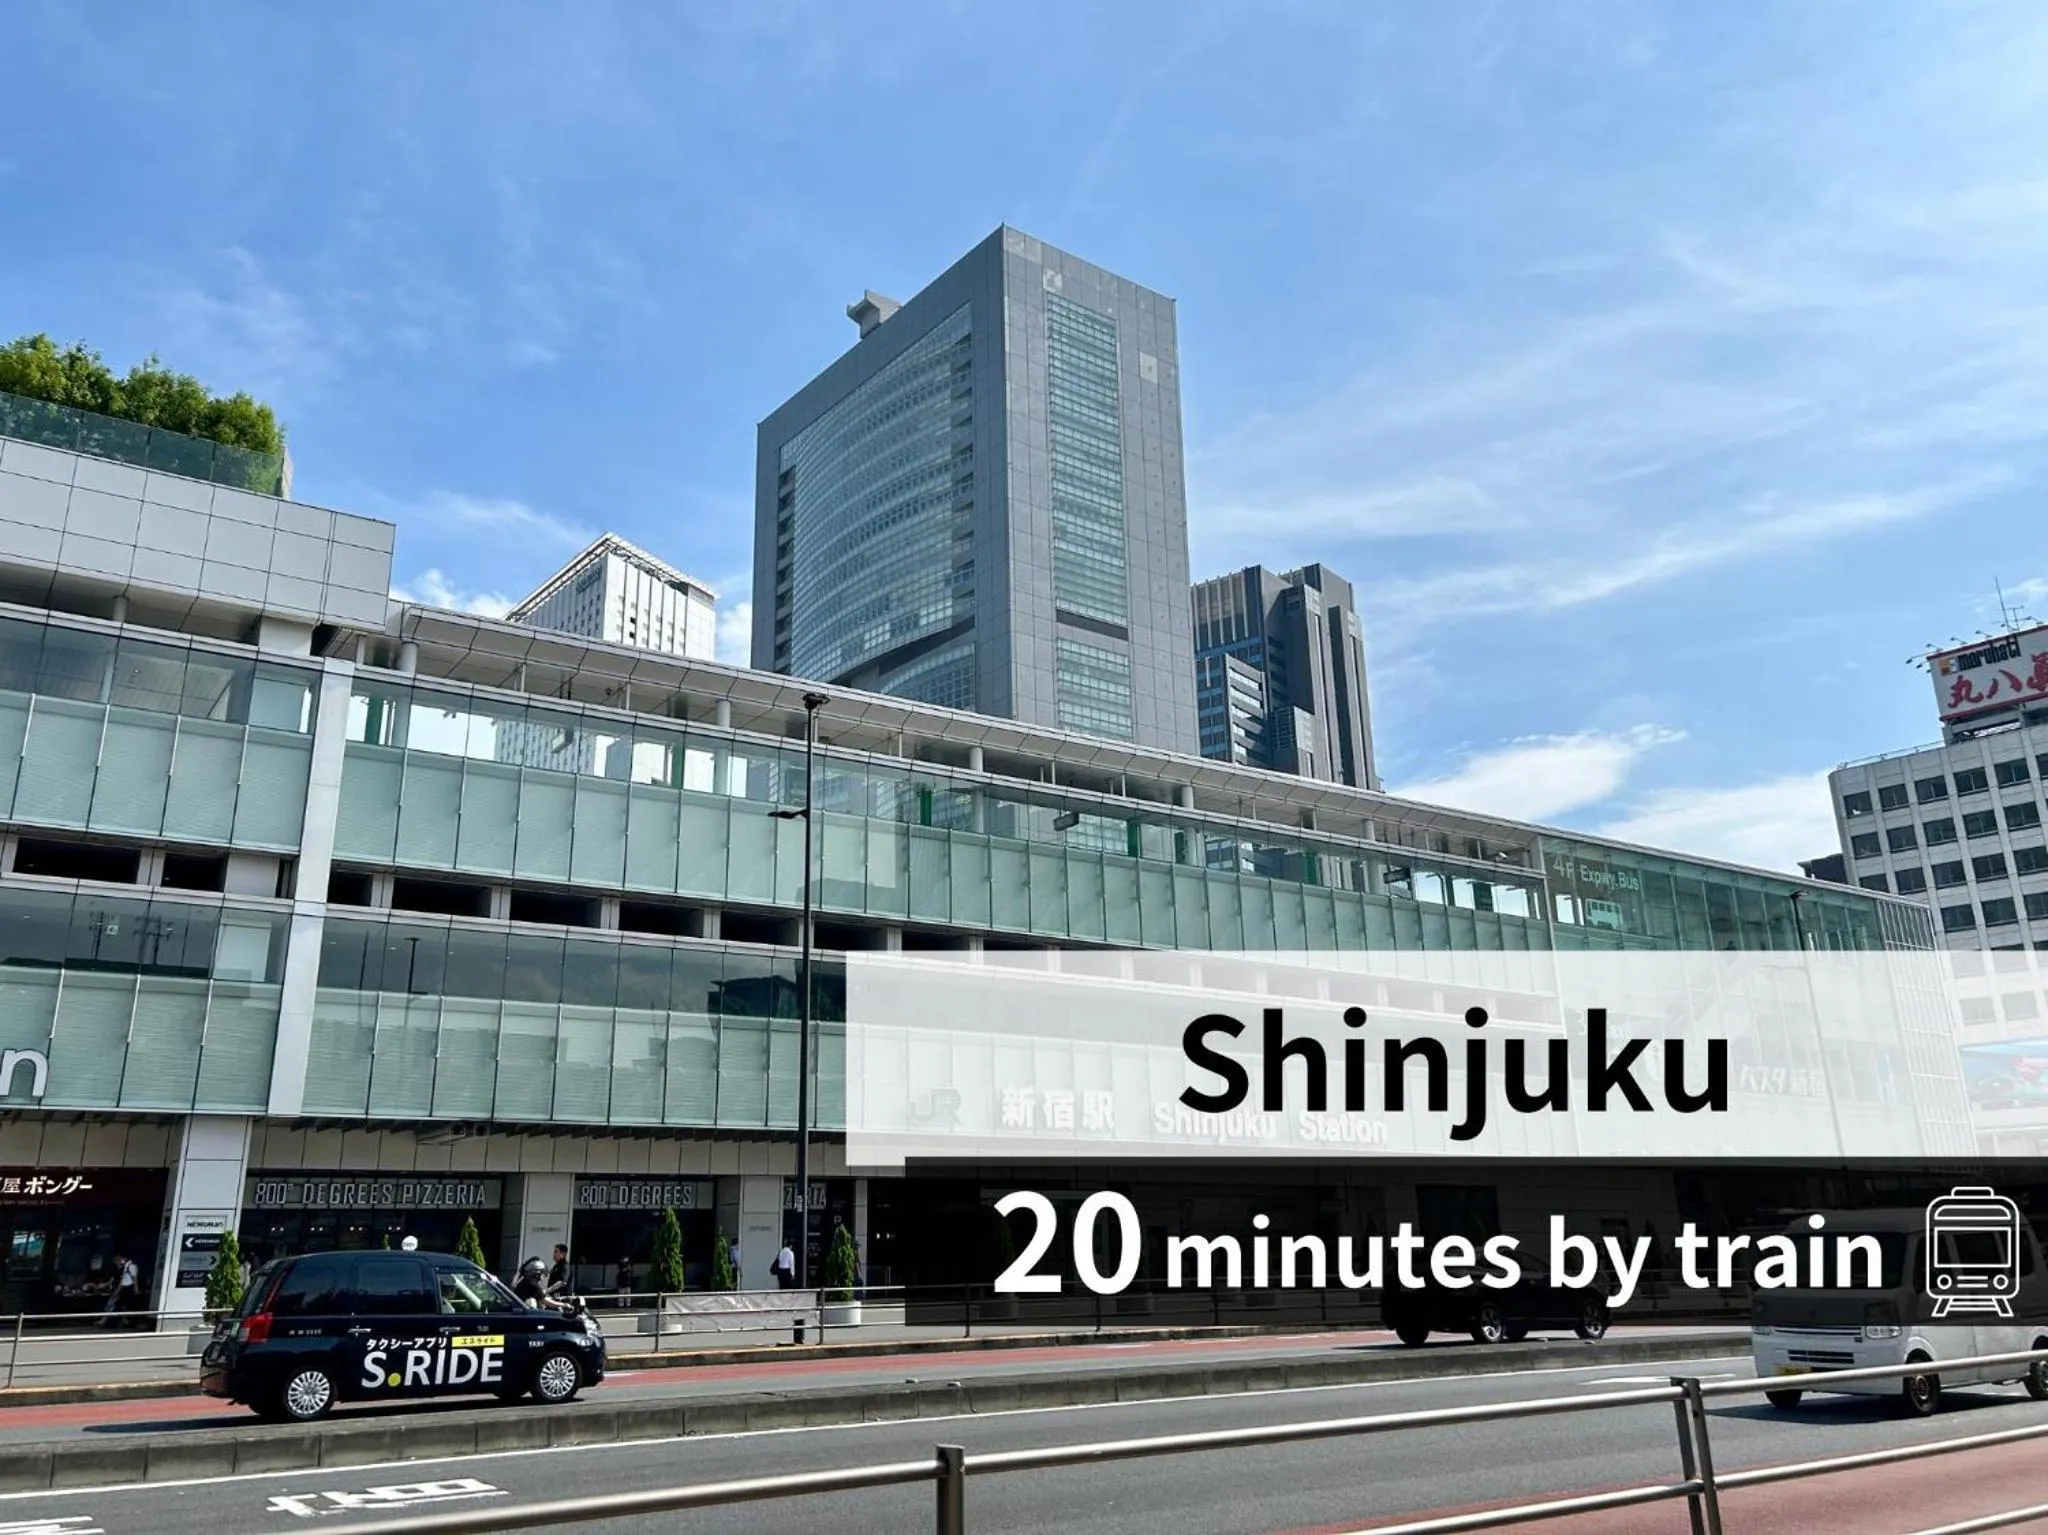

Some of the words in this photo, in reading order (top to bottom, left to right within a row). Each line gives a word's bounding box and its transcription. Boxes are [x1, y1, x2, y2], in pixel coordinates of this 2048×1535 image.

[1001, 1084, 1116, 1132] 新宿駅
[1154, 1101, 1278, 1145] Shinjuku
[1299, 1109, 1389, 1144] Station
[302, 1183, 394, 1205] DEGREES
[402, 1184, 486, 1205] PIZZERIA
[619, 1186, 692, 1205] DEGREES
[365, 1336, 448, 1351] タクシーアプリ
[361, 1347, 505, 1388] S.RIDE
